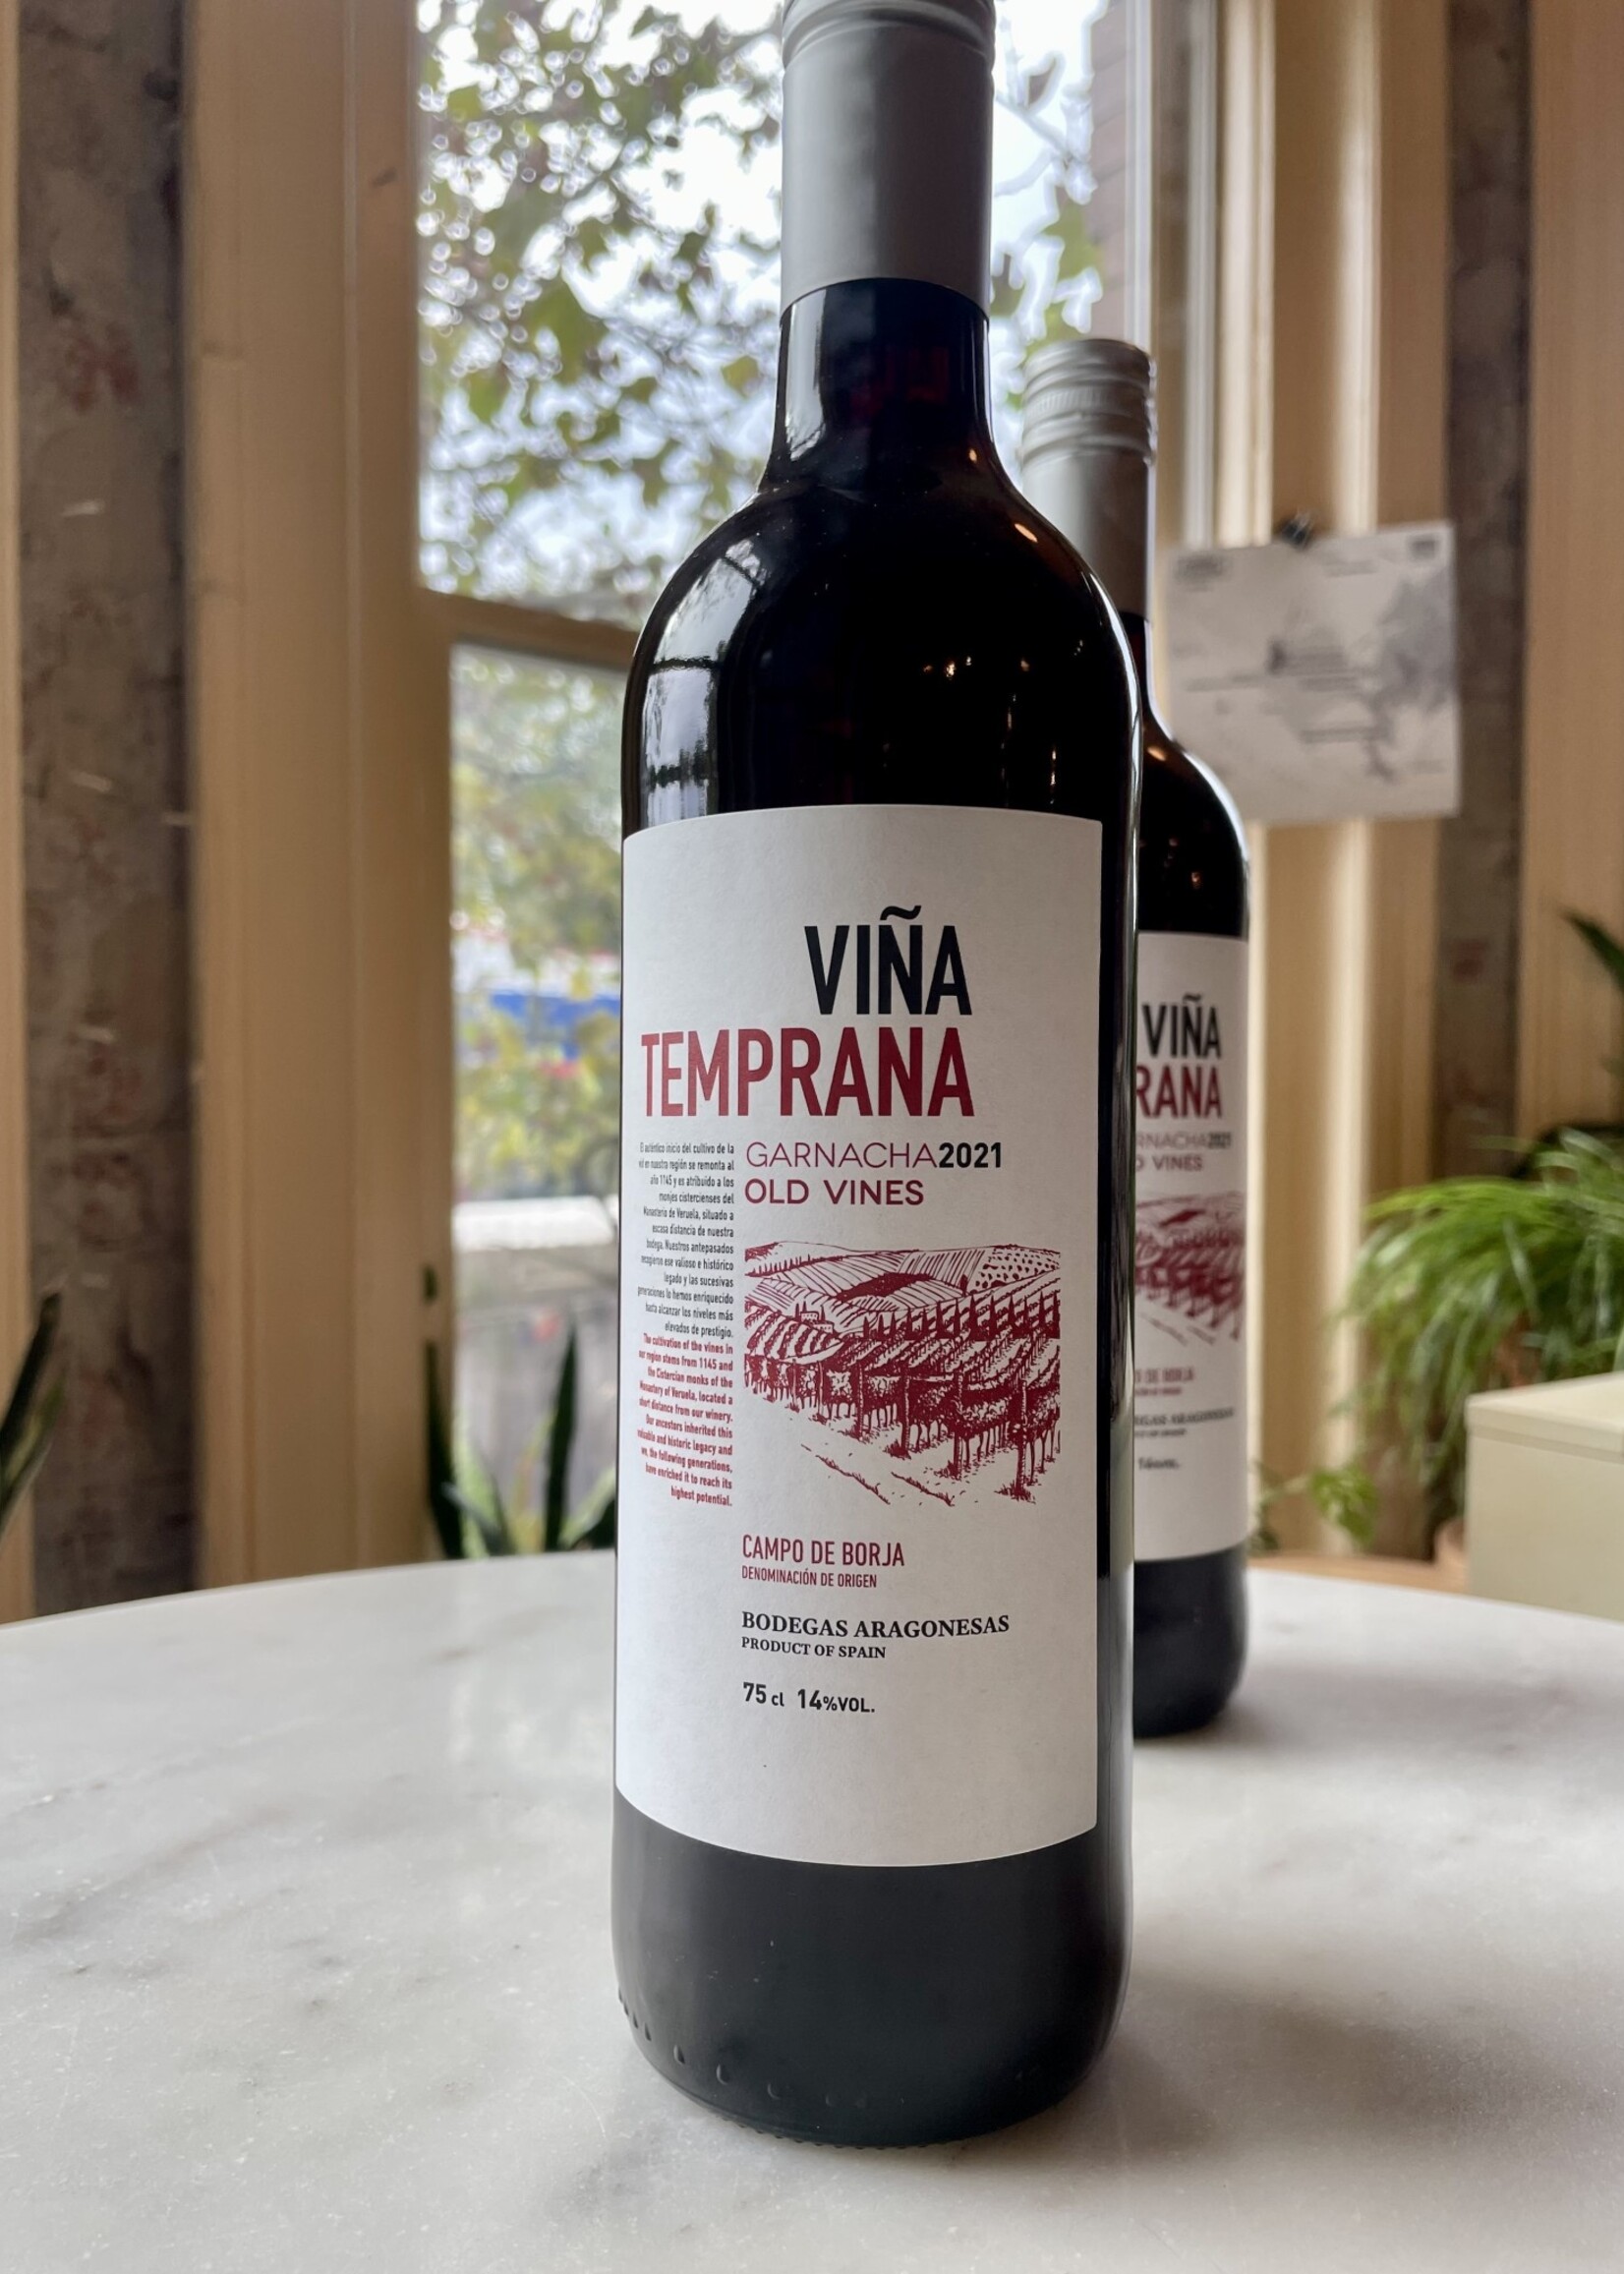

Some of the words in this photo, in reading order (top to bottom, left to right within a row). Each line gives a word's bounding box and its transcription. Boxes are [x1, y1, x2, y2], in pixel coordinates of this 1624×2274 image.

[804, 904, 972, 1016] VIÑA
[1142, 992, 1221, 1059] VIÑA
[641, 1026, 975, 1117] TEMPRANA
[682, 1142, 691, 1153] del
[693, 1142, 716, 1154] cultivo
[717, 1143, 725, 1154] de
[727, 1143, 734, 1154] la
[688, 1161, 696, 1170] se
[697, 1160, 725, 1171] remonta
[727, 1160, 734, 1171] al
[1151, 1153, 1202, 1171] VINES
[678, 1177, 685, 1186] es
[686, 1175, 716, 1187] atribuido
[724, 1176, 734, 1188] los
[679, 1192, 721, 1203] cistercienses
[723, 1193, 734, 1203] del
[745, 1178, 809, 1205] OLD
[824, 1179, 925, 1206] VINES
[668, 1207, 675, 1218] de
[676, 1207, 701, 1220] Veruela,
[702, 1209, 727, 1220] situado
[669, 1223, 696, 1236] distancia
[698, 1225, 706, 1236] de
[707, 1227, 734, 1237] nuestra
[665, 1240, 689, 1252] Nuestros
[691, 1243, 734, 1254] antepasados
[674, 1257, 696, 1268] valioso
[703, 1258, 734, 1270] histórico
[683, 1276, 687, 1286] y
[688, 1274, 698, 1285] las
[700, 1276, 734, 1287] sucesivas
[672, 1289, 692, 1301] hemos
[693, 1291, 733, 1304] enriquecido
[659, 1305, 680, 1316] alcanzar
[682, 1306, 691, 1317] los
[693, 1308, 717, 1319] niveles
[718, 1310, 733, 1320] más
[691, 1324, 699, 1335] de
[701, 1325, 733, 1339] prestigio.
[653, 1335, 681, 1349] cultivation
[682, 1339, 690, 1350] of
[691, 1340, 702, 1351] the
[704, 1342, 724, 1354] vines
[725, 1343, 733, 1355] in
[663, 1354, 680, 1366] stems
[681, 1356, 697, 1368] from
[700, 1358, 717, 1370] 1145
[719, 1360, 733, 1371] and
[657, 1368, 685, 1382] Cistercian
[686, 1373, 709, 1385] monks
[711, 1375, 719, 1386] of
[721, 1376, 733, 1388] the
[671, 1386, 698, 1402] Veruela,
[699, 1390, 725, 1404] located
[727, 1396, 733, 1405] a
[651, 1399, 673, 1414] distance
[674, 1404, 690, 1416] from
[692, 1408, 703, 1418] our
[706, 1409, 733, 1424] winery.
[655, 1418, 683, 1431] ancestors
[684, 1422, 716, 1436] inherited
[718, 1426, 732, 1438] this
[657, 1434, 667, 1445] and
[667, 1434, 691, 1449] historic
[693, 1439, 716, 1456] legacy
[718, 1444, 732, 1455] and
[659, 1449, 686, 1468] following
[687, 1458, 732, 1473] generations,
[658, 1467, 682, 1482] enriched
[684, 1472, 689, 1483] it
[691, 1473, 698, 1484] to
[700, 1476, 721, 1487] reach
[722, 1478, 732, 1489] its
[670, 1485, 695, 1500] highest
[696, 1491, 732, 1506] potential.
[742, 1534, 803, 1563] CAMPO
[811, 1541, 836, 1565] DE
[842, 1542, 905, 1567] BORJA
[741, 1565, 817, 1586] DENOMINACIÓN
[820, 1573, 835, 1587] DE
[838, 1573, 877, 1589] ORIGEN
[741, 1611, 848, 1637] BODEGAS
[853, 1615, 1010, 1639] ARAGONESAS
[741, 1636, 811, 1656] PRODUCT
[814, 1645, 835, 1658] OF
[839, 1646, 887, 1659] SPAIN
[743, 1682, 767, 1704] 75
[771, 1691, 784, 1707] cl
